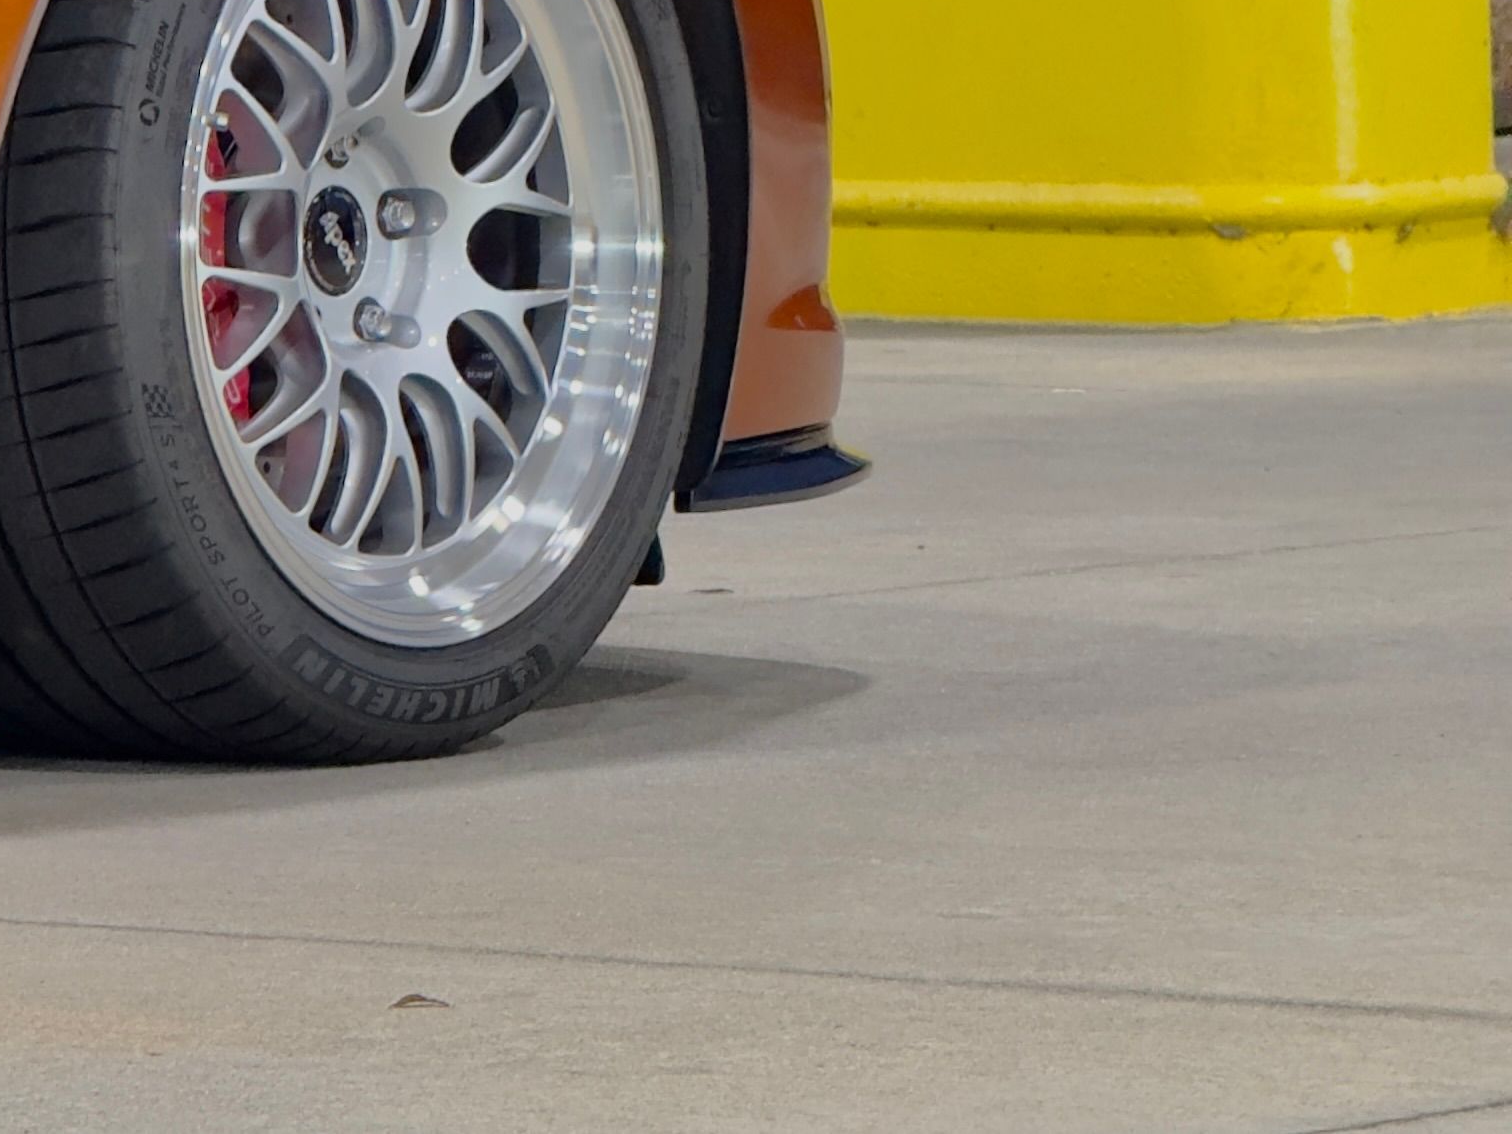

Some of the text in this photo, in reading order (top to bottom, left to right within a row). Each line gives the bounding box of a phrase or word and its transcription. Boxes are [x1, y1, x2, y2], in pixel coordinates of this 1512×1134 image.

[173, 477, 226, 566] SPORT
[221, 577, 275, 640] PILOT
[292, 649, 500, 722] MICHELIN
